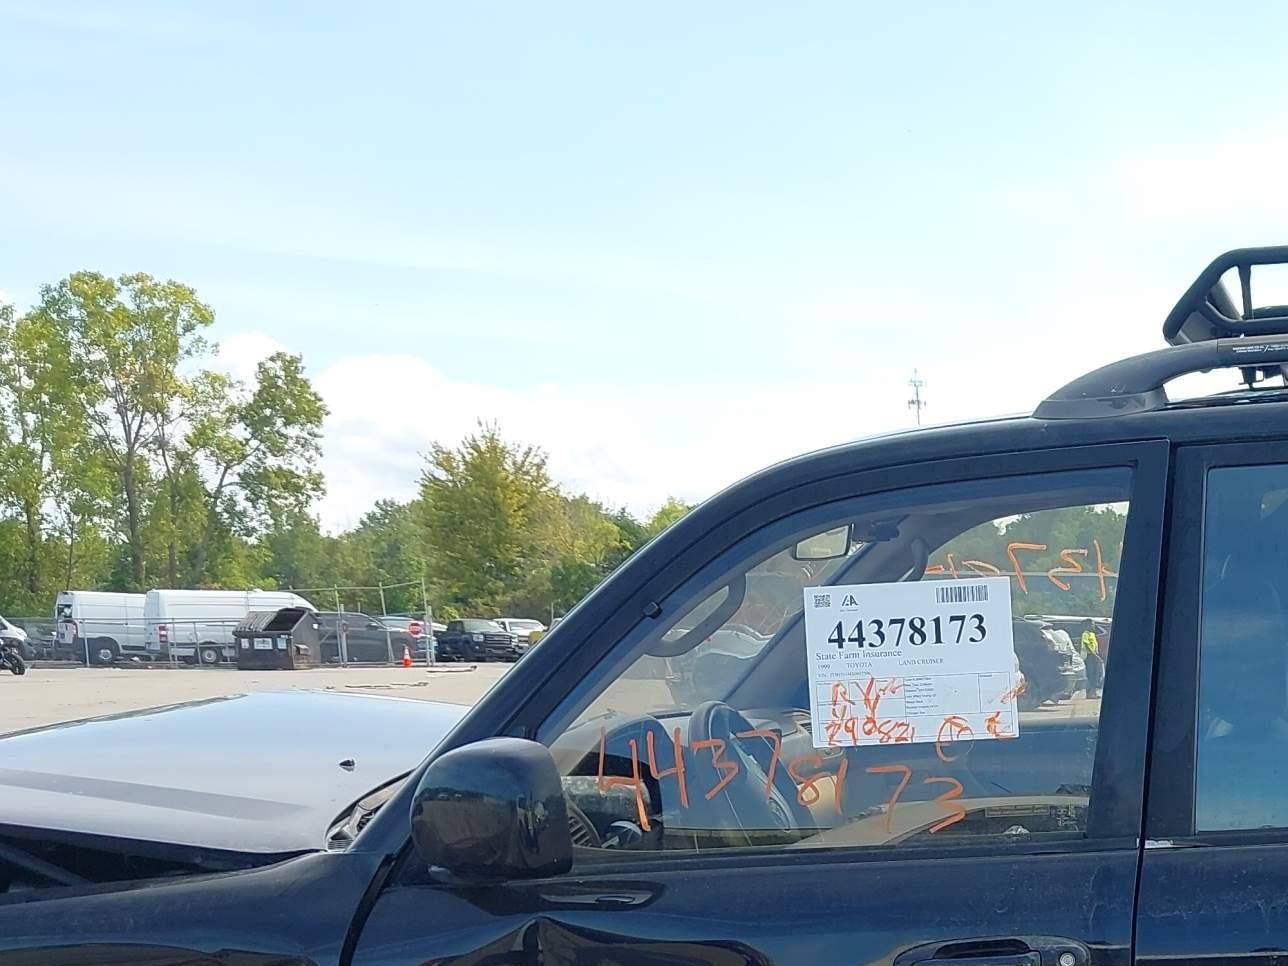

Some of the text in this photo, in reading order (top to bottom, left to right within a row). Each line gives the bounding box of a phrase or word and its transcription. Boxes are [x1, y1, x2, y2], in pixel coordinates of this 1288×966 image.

[827, 613, 988, 650] 44378173
[815, 649, 902, 661] State Farm Insurance
[846, 661, 873, 670] TOYOTA
